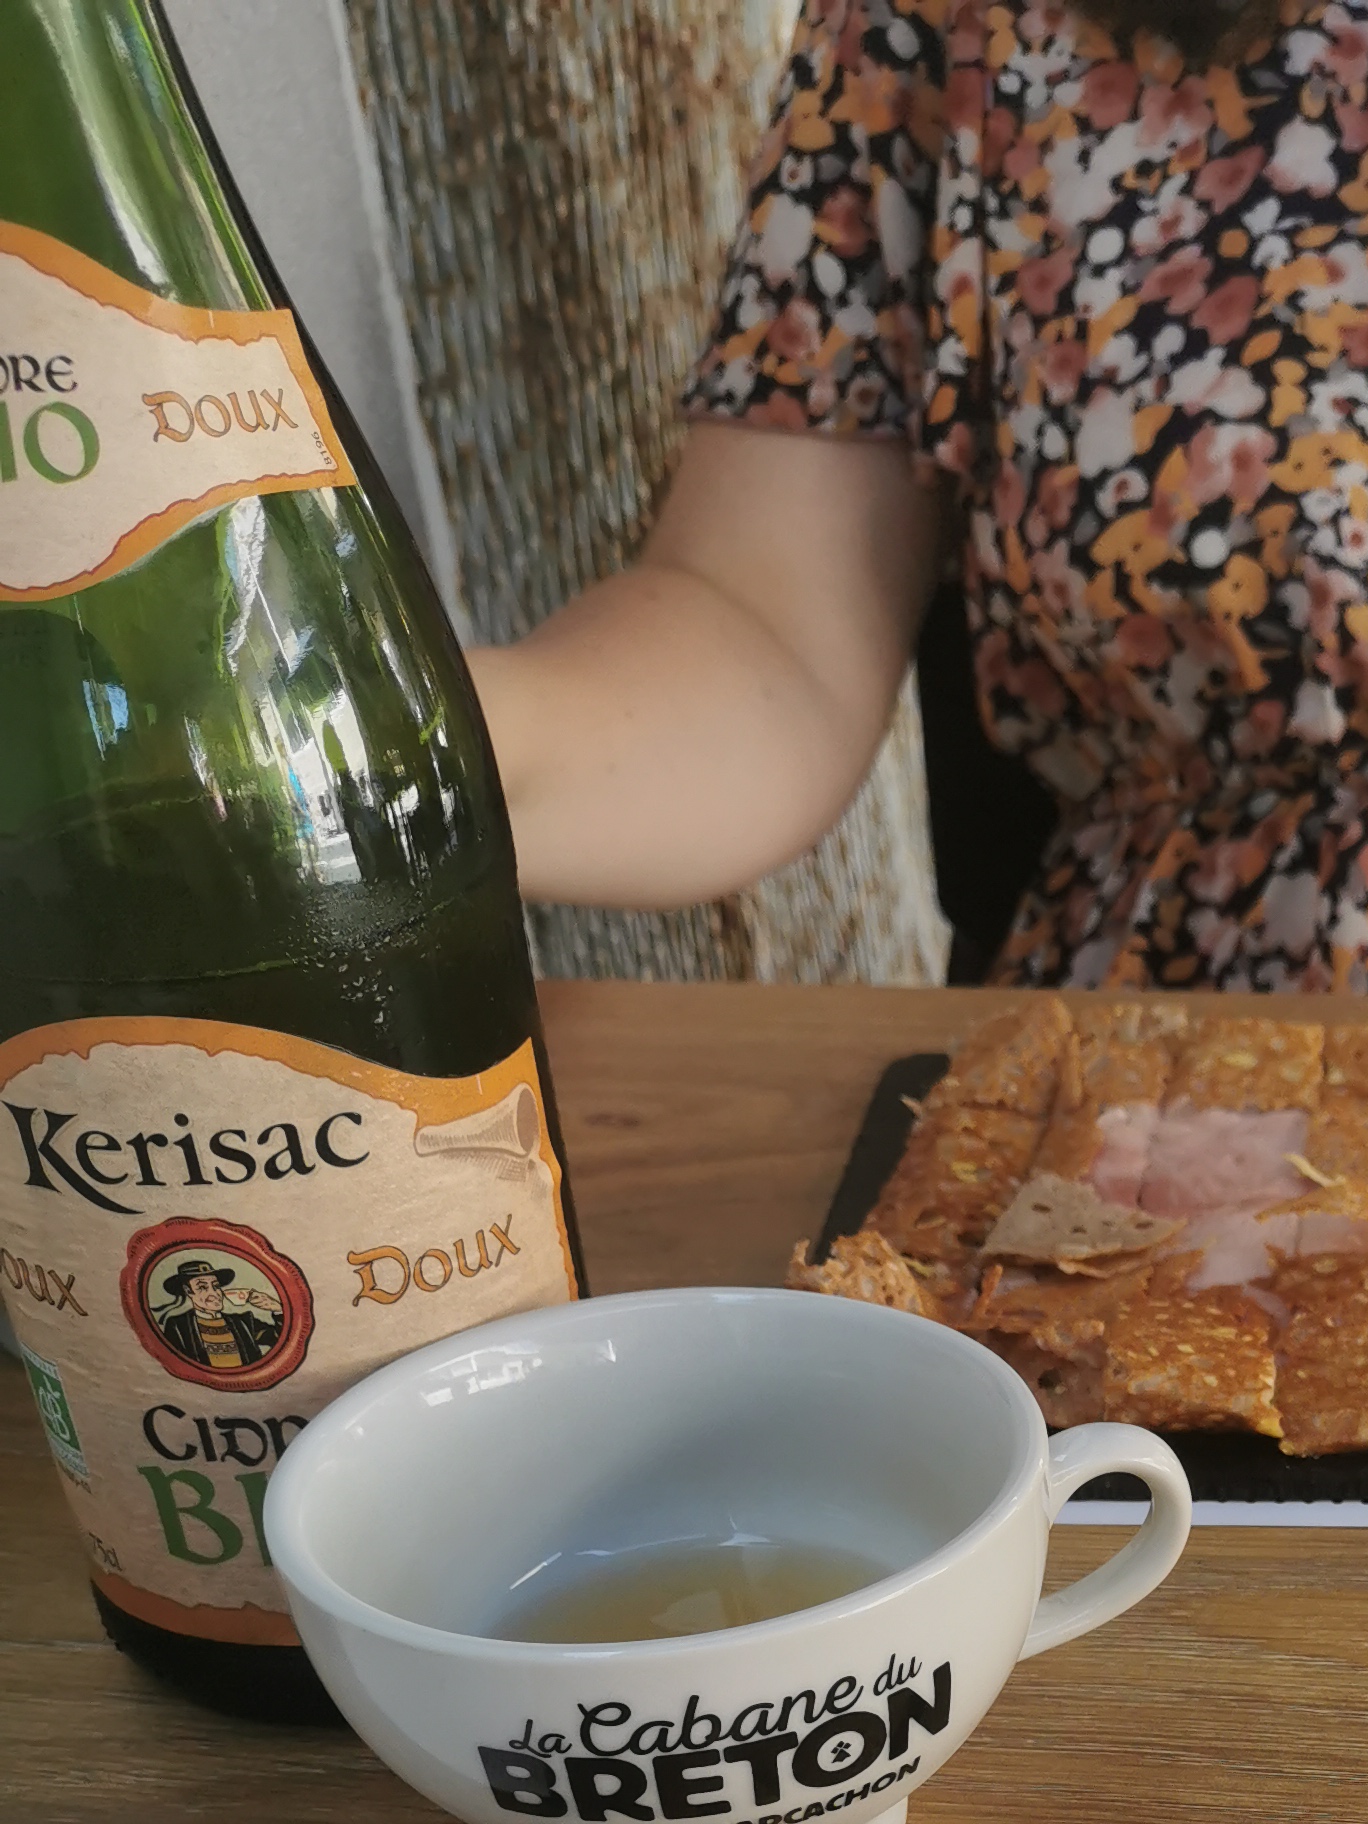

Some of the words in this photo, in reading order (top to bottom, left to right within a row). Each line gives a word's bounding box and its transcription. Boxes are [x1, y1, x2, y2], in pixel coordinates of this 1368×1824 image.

[0, 354, 78, 395] RE
[3, 1101, 370, 1215] Kerisac
[477, 1660, 952, 1822] BRETON
[508, 1718, 573, 1758] La
[577, 1675, 864, 1757] Cabane
[873, 1653, 923, 1696] du
